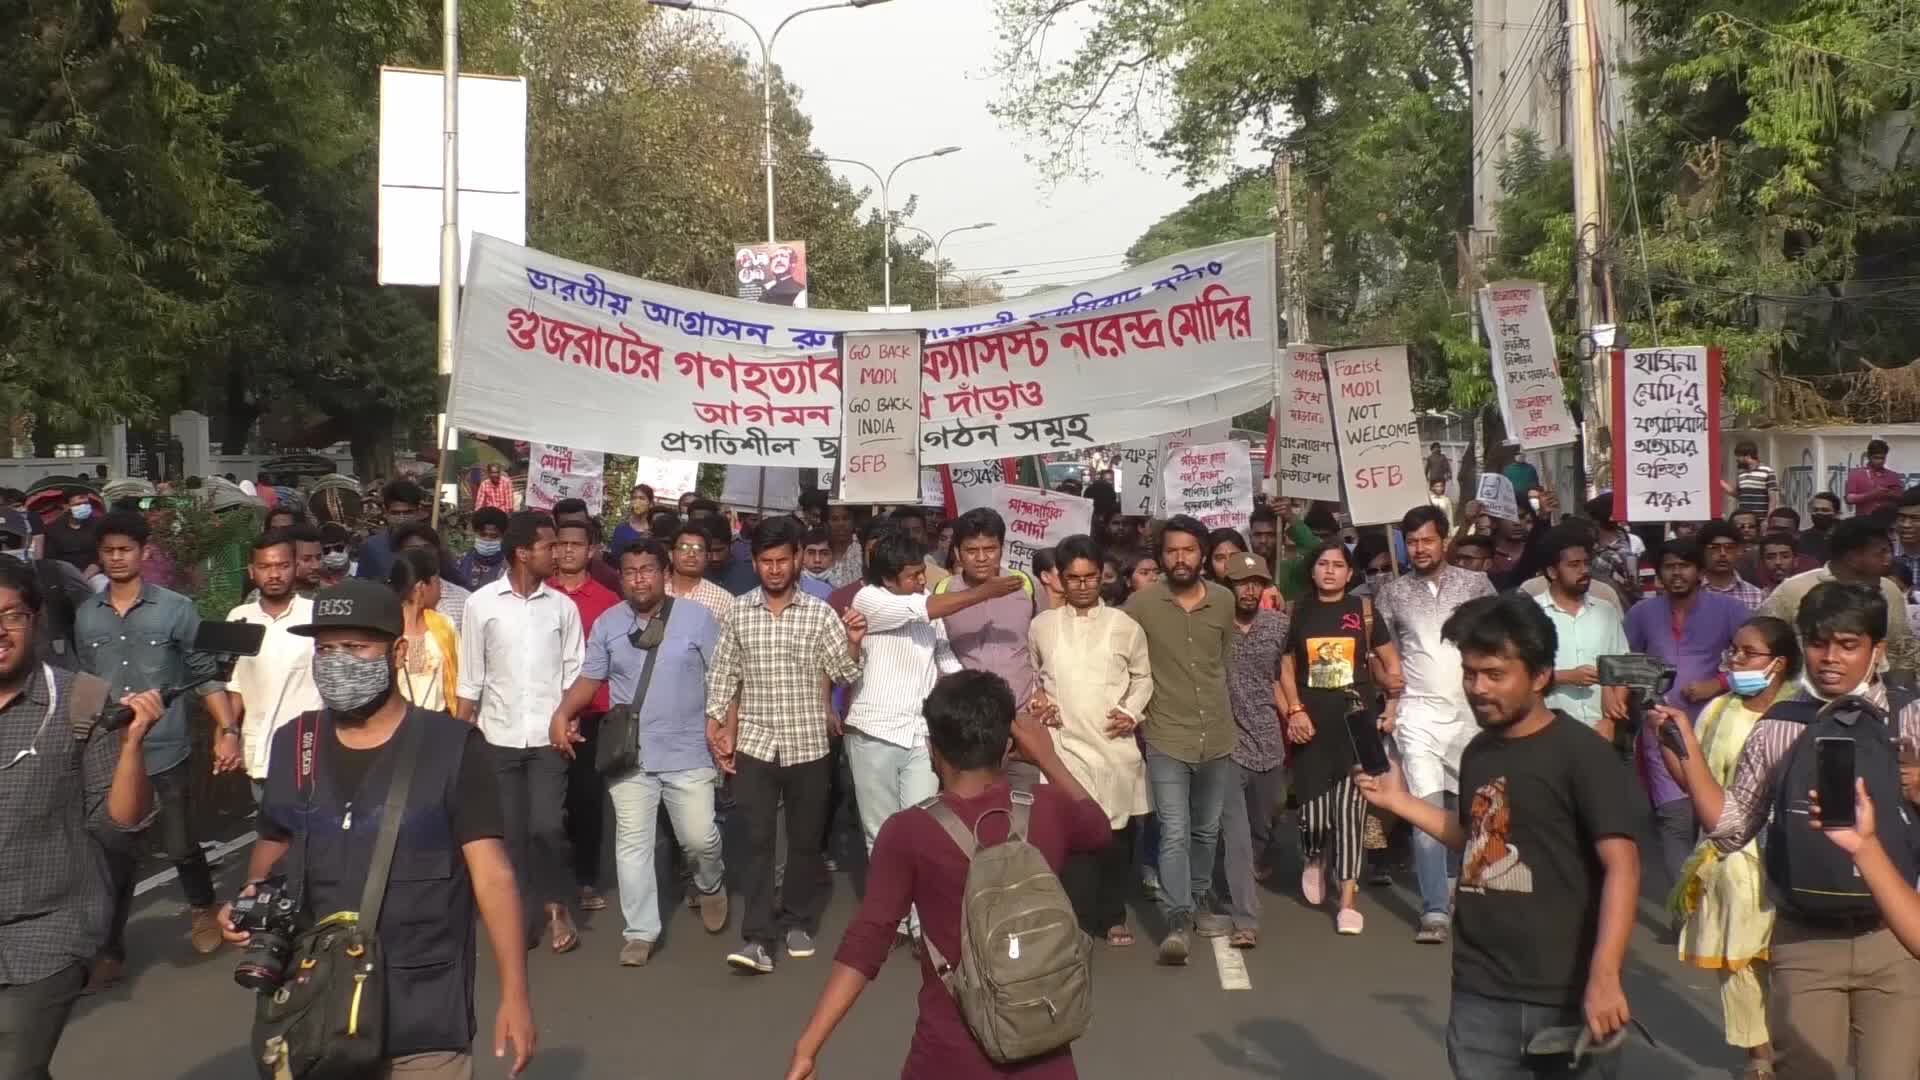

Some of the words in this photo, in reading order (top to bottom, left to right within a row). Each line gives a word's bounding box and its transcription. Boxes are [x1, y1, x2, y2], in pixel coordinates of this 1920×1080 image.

[526, 267, 632, 316] ভারতীয়
[641, 300, 774, 344] আগ্রাসন
[507, 308, 664, 382] গুজরাটের
[1056, 309, 1166, 358] নরেন্দ্র
[1168, 283, 1252, 347] মোদির
[849, 344, 871, 361] GO
[879, 344, 911, 360] BACK
[1633, 349, 1697, 375] হাসিনা
[860, 367, 897, 384] MODI
[1334, 358, 1382, 376] Facist
[1341, 379, 1381, 398] MODI
[692, 400, 834, 427] আগমন
[944, 381, 1044, 420] দাঁড়াও
[849, 398, 871, 414] GO
[877, 397, 913, 412] BACK
[1348, 403, 1382, 423] NOT
[661, 426, 800, 457] প্রগতিশীল
[1008, 413, 1095, 448] সমূহ
[857, 418, 896, 436] INDIA
[1345, 420, 1419, 445] WELCOME
[1632, 438, 1699, 457] অত্যাচার
[850, 454, 887, 473] SFB
[1355, 464, 1403, 489] SFB
[1638, 490, 1702, 513] করুন
[318, 598, 354, 616] BOSS
